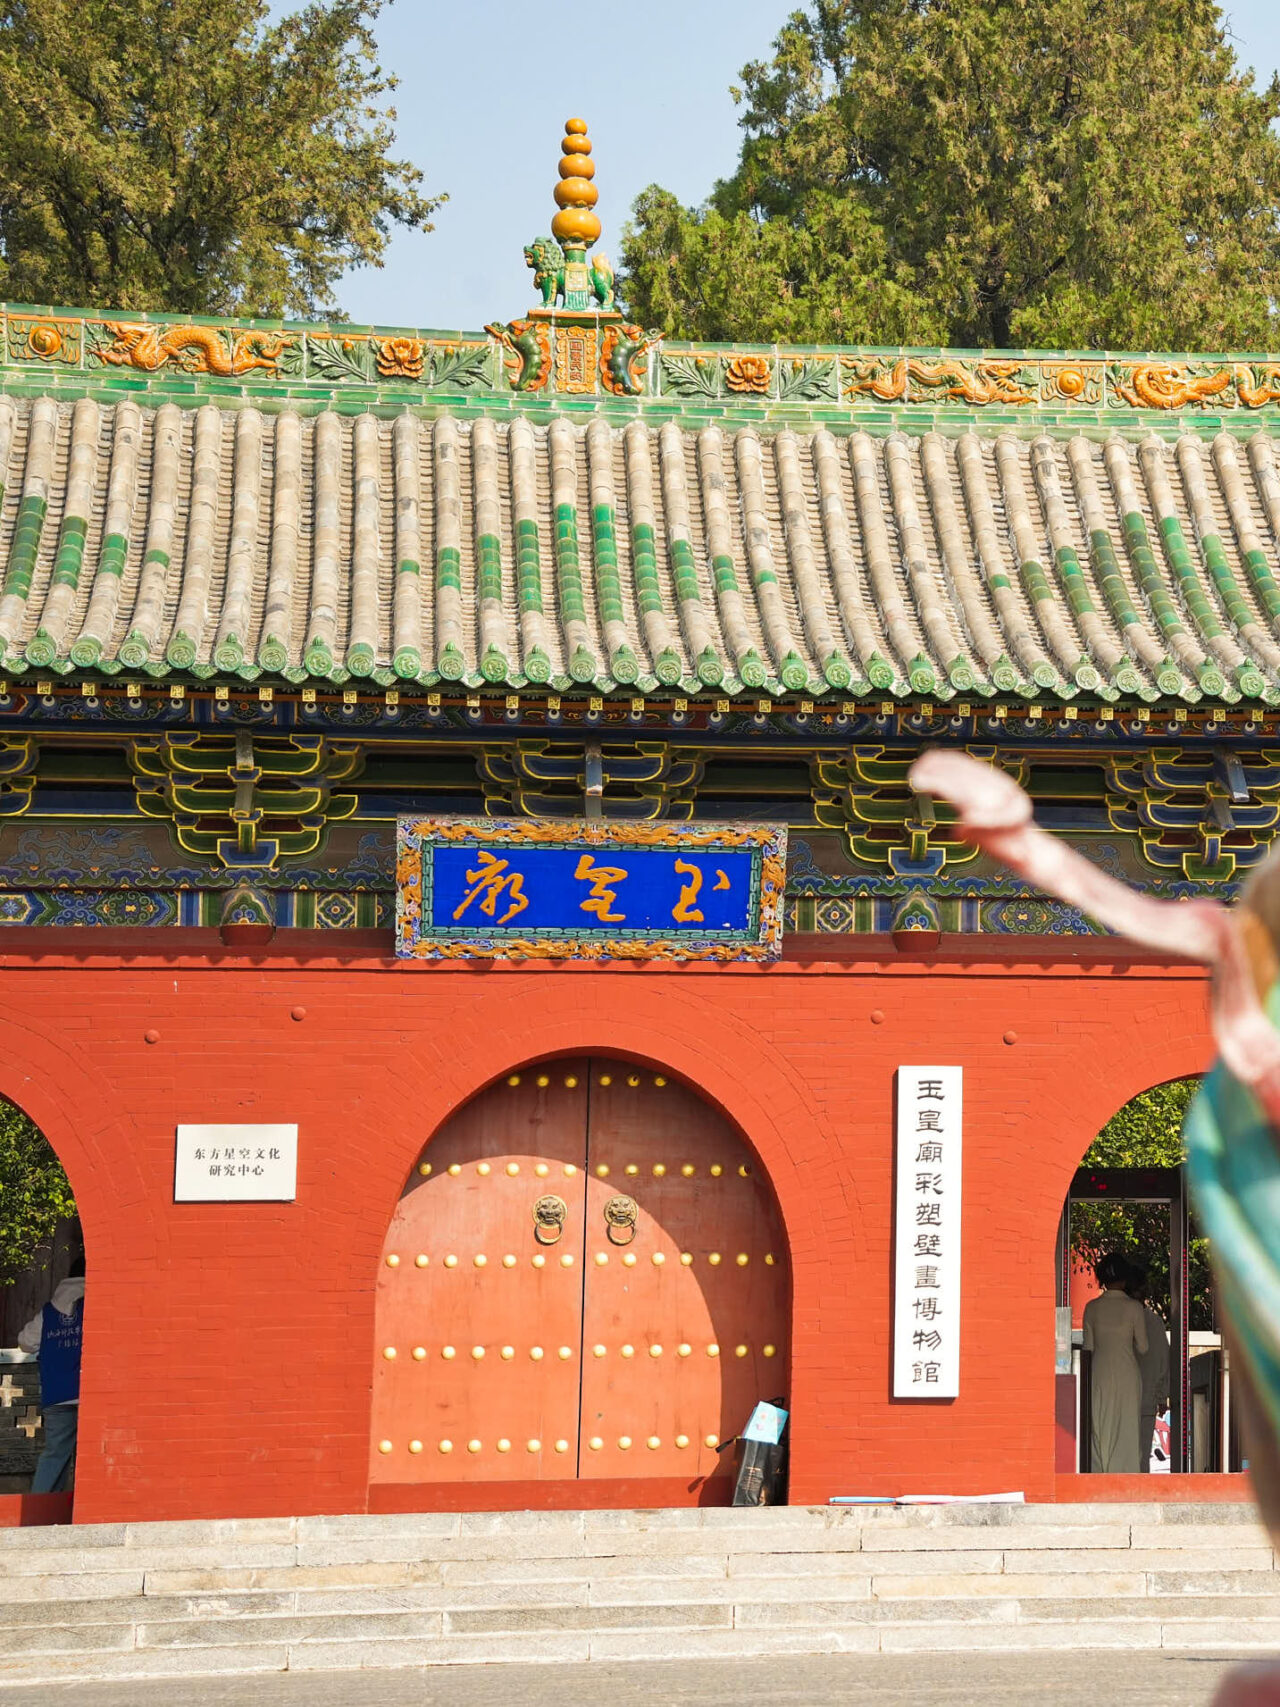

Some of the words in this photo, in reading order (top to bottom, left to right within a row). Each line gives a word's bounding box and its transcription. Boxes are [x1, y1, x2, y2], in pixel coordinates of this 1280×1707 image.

[194, 1148, 280, 1160] 东方星空文化
[209, 1164, 265, 1176] 研究中心
